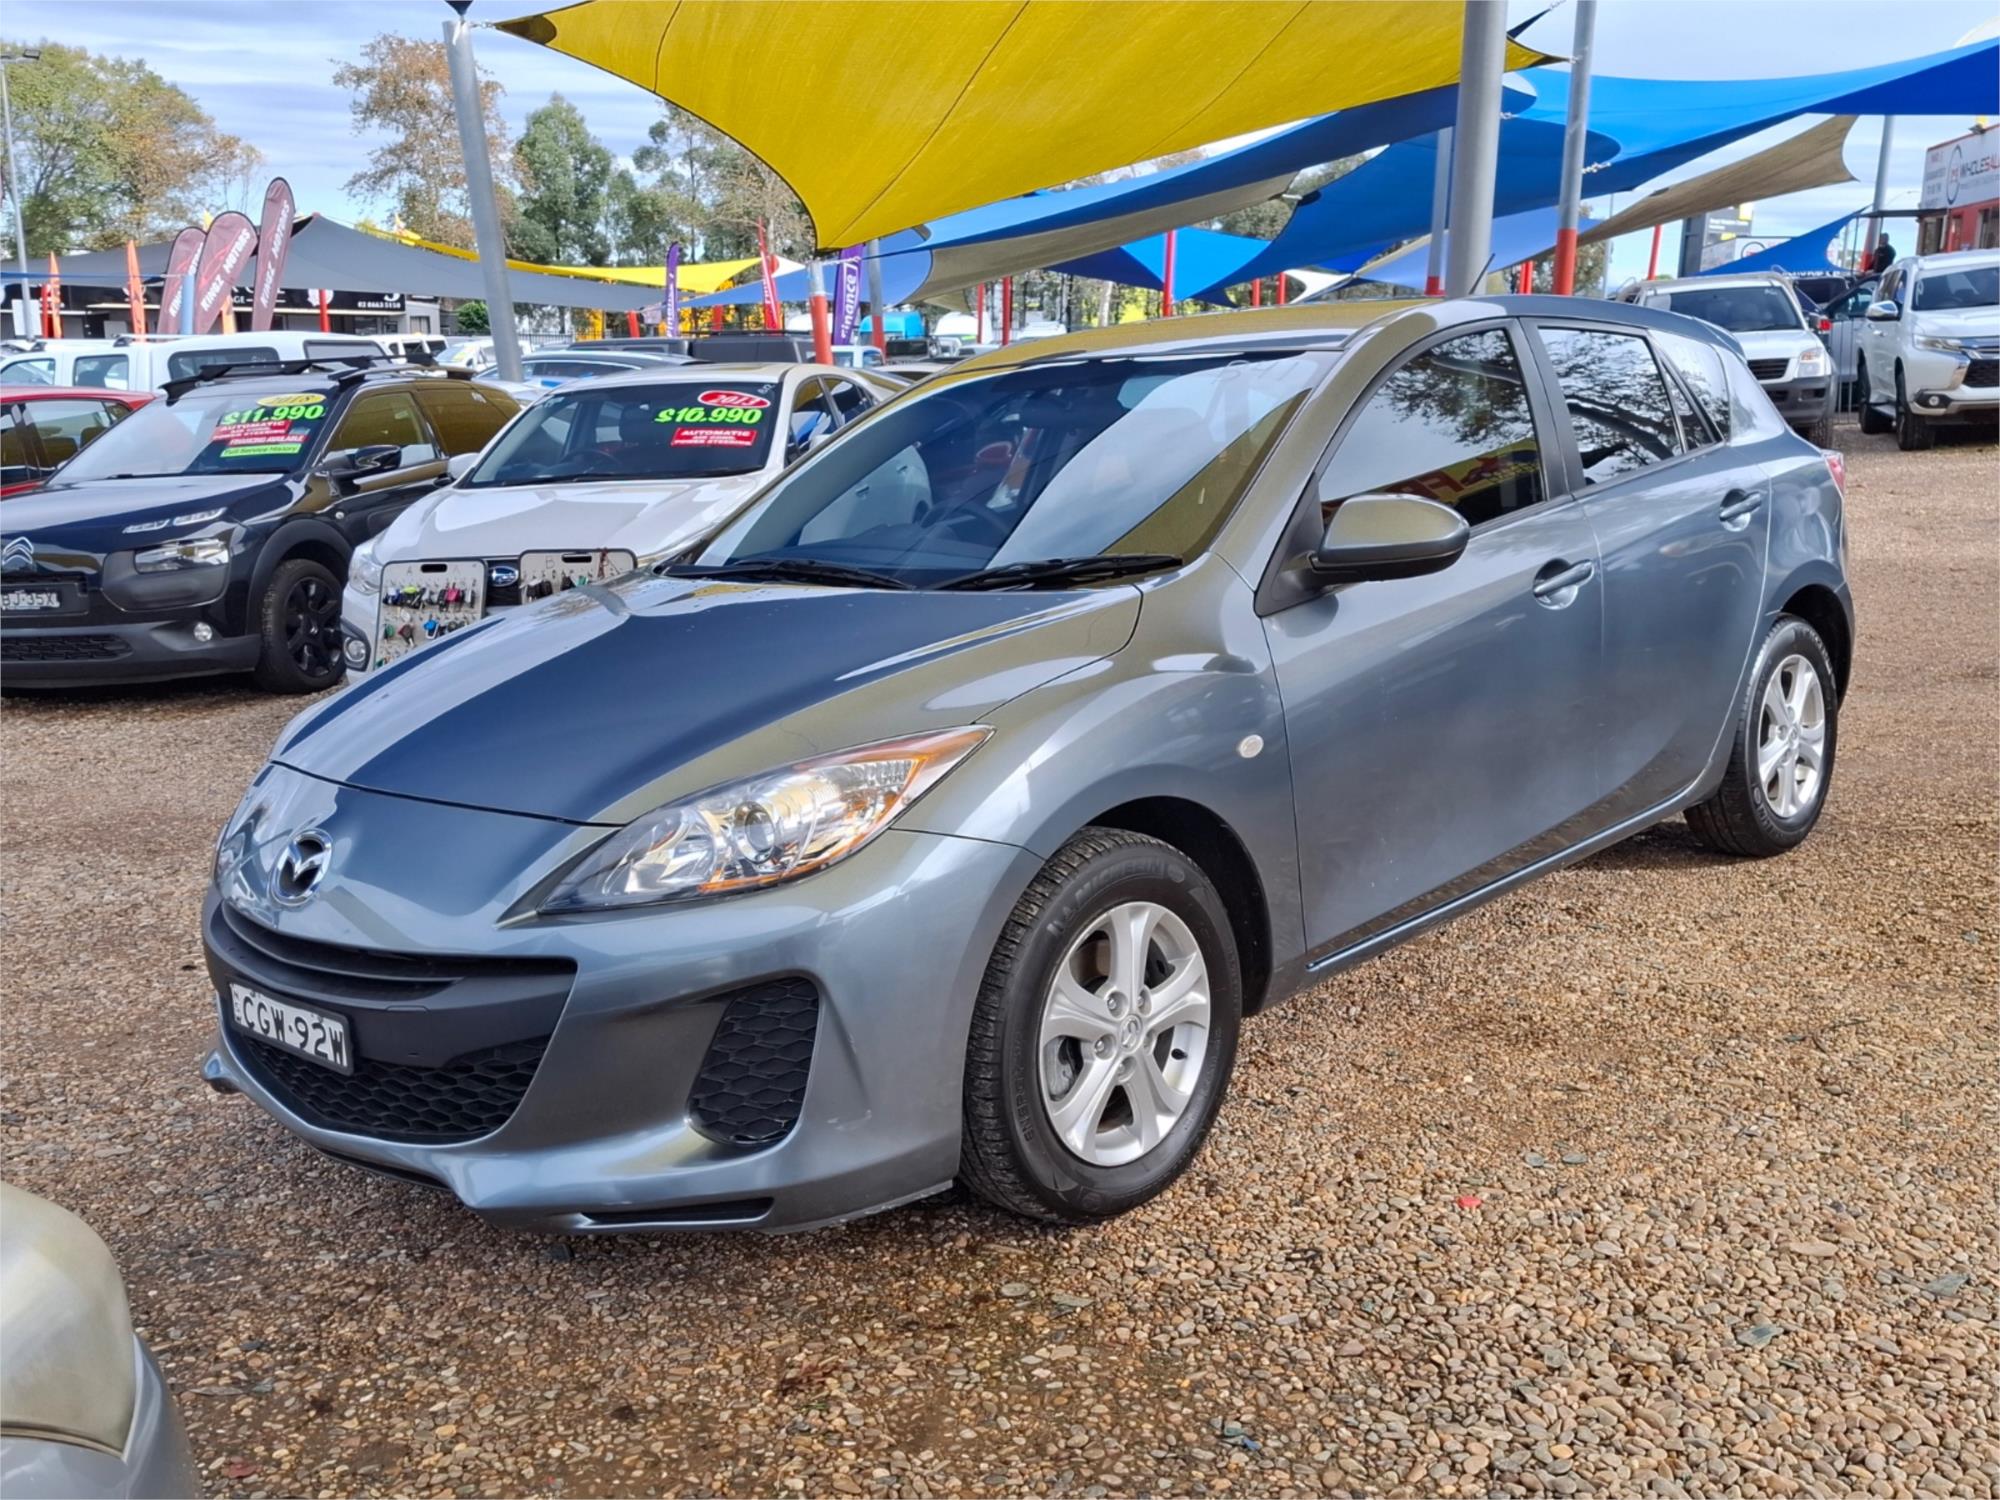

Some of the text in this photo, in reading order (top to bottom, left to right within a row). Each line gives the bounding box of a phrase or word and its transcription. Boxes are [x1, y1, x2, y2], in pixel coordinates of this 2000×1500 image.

[200, 274, 225, 312] KINGZ
[222, 228, 251, 274] MOTORS
[260, 261, 275, 308] KINGZ
[680, 429, 752, 437] AUTOMATIC
